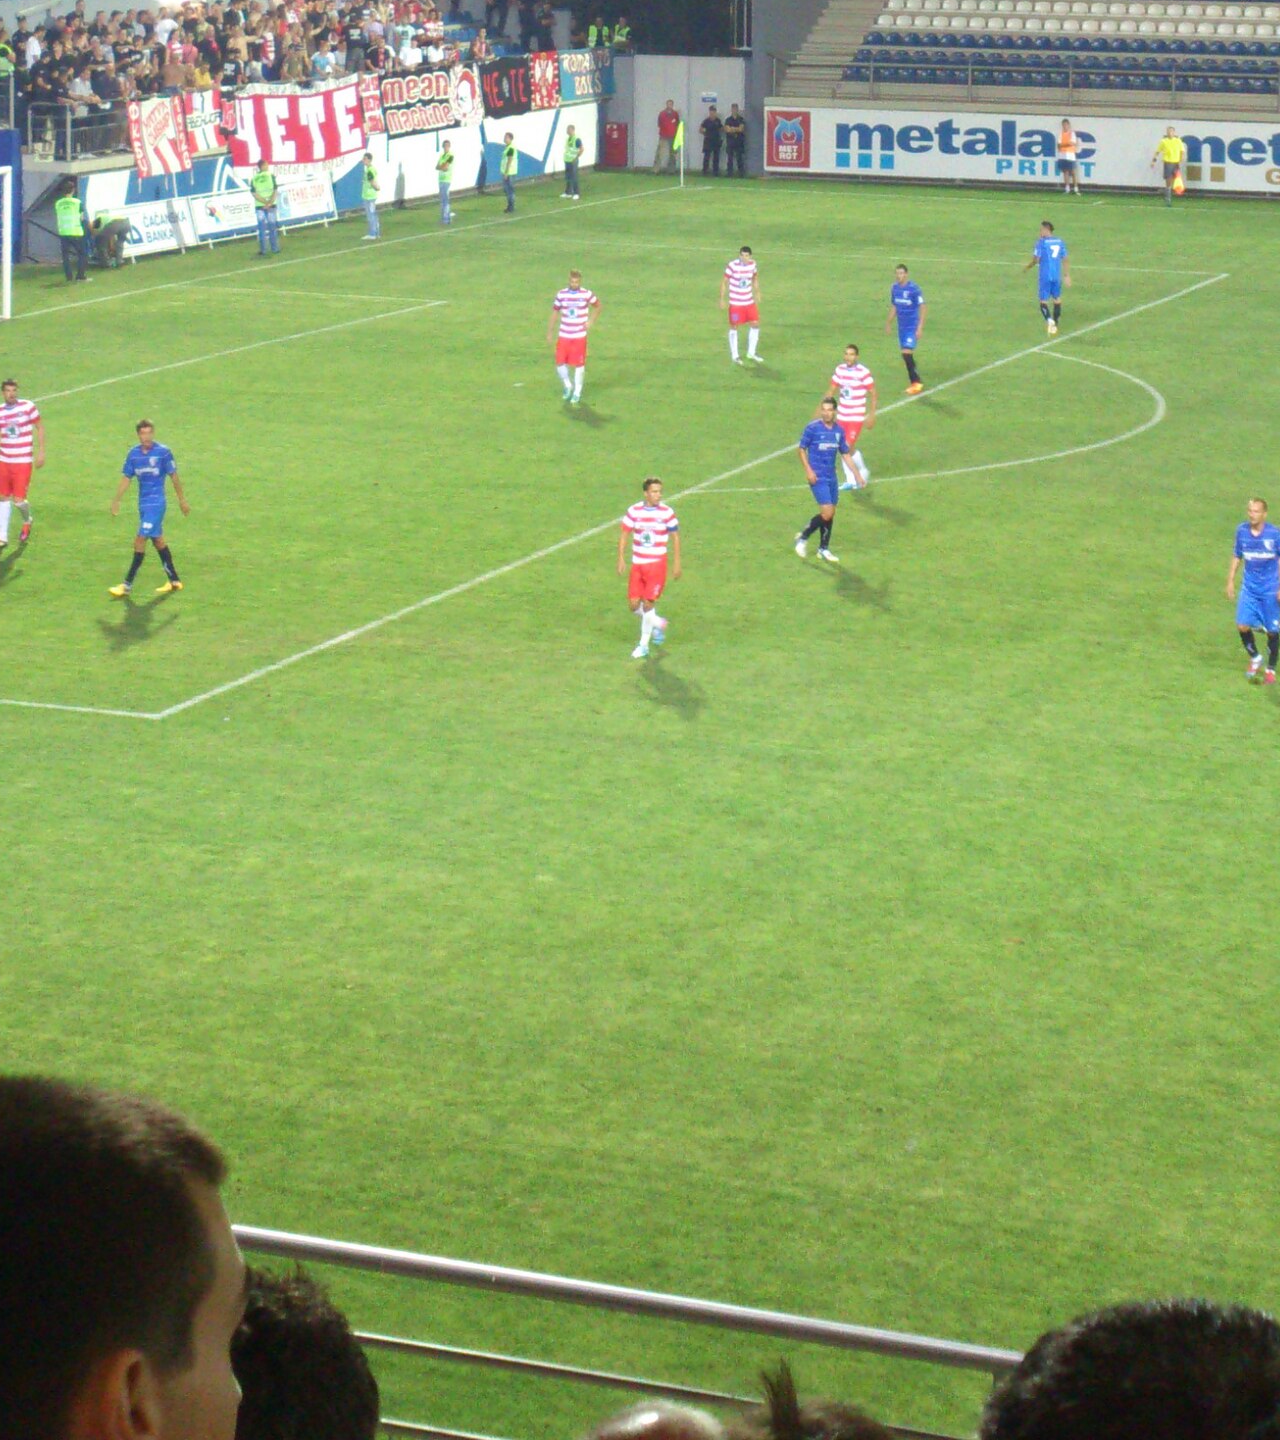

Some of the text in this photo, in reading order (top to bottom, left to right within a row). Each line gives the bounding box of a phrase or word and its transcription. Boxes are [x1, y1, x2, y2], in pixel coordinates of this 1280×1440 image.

[836, 119, 1096, 160] metalac
[996, 158, 1096, 178] PRIT
[145, 229, 176, 244] BANKA
[1050, 245, 1060, 258] 7
